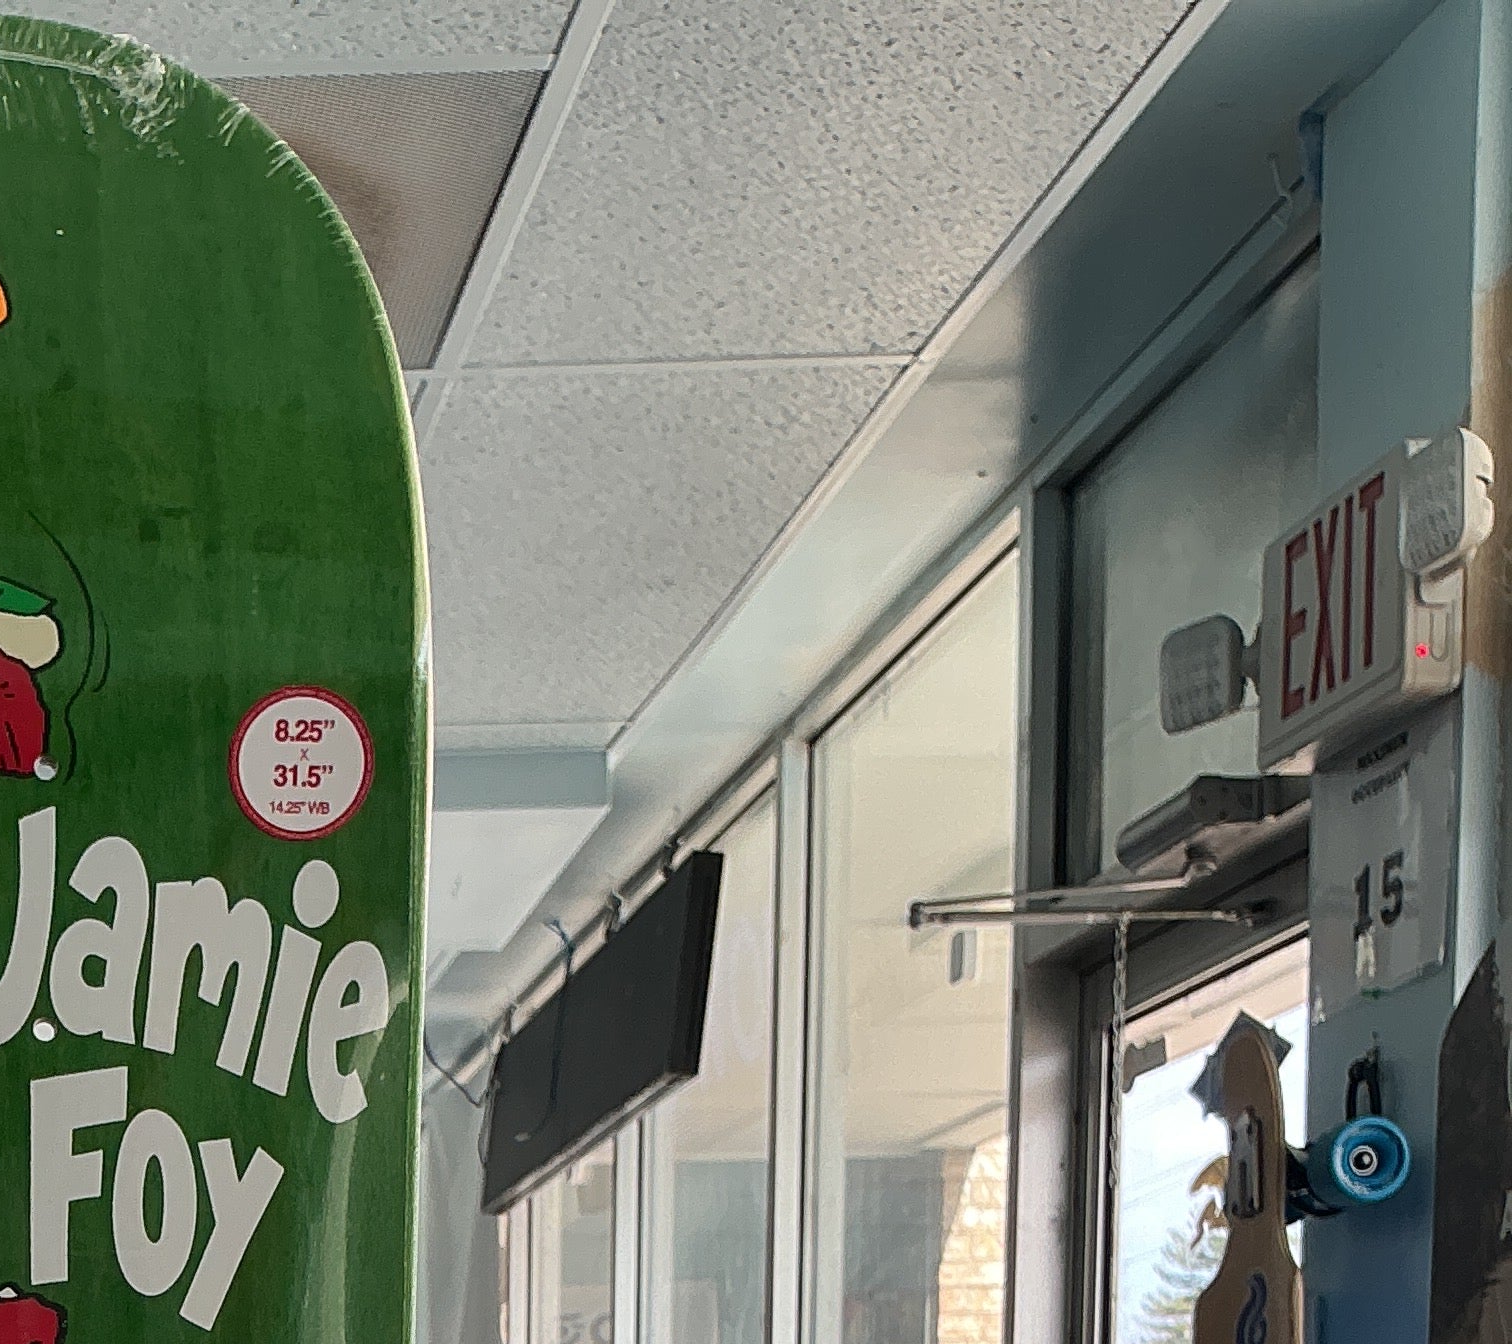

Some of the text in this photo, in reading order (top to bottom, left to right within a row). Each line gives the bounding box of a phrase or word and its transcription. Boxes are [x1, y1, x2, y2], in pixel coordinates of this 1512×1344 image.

[1281, 470, 1385, 721] EXIT
[307, 800, 331, 815] WB
[1353, 849, 1404, 943] 15
